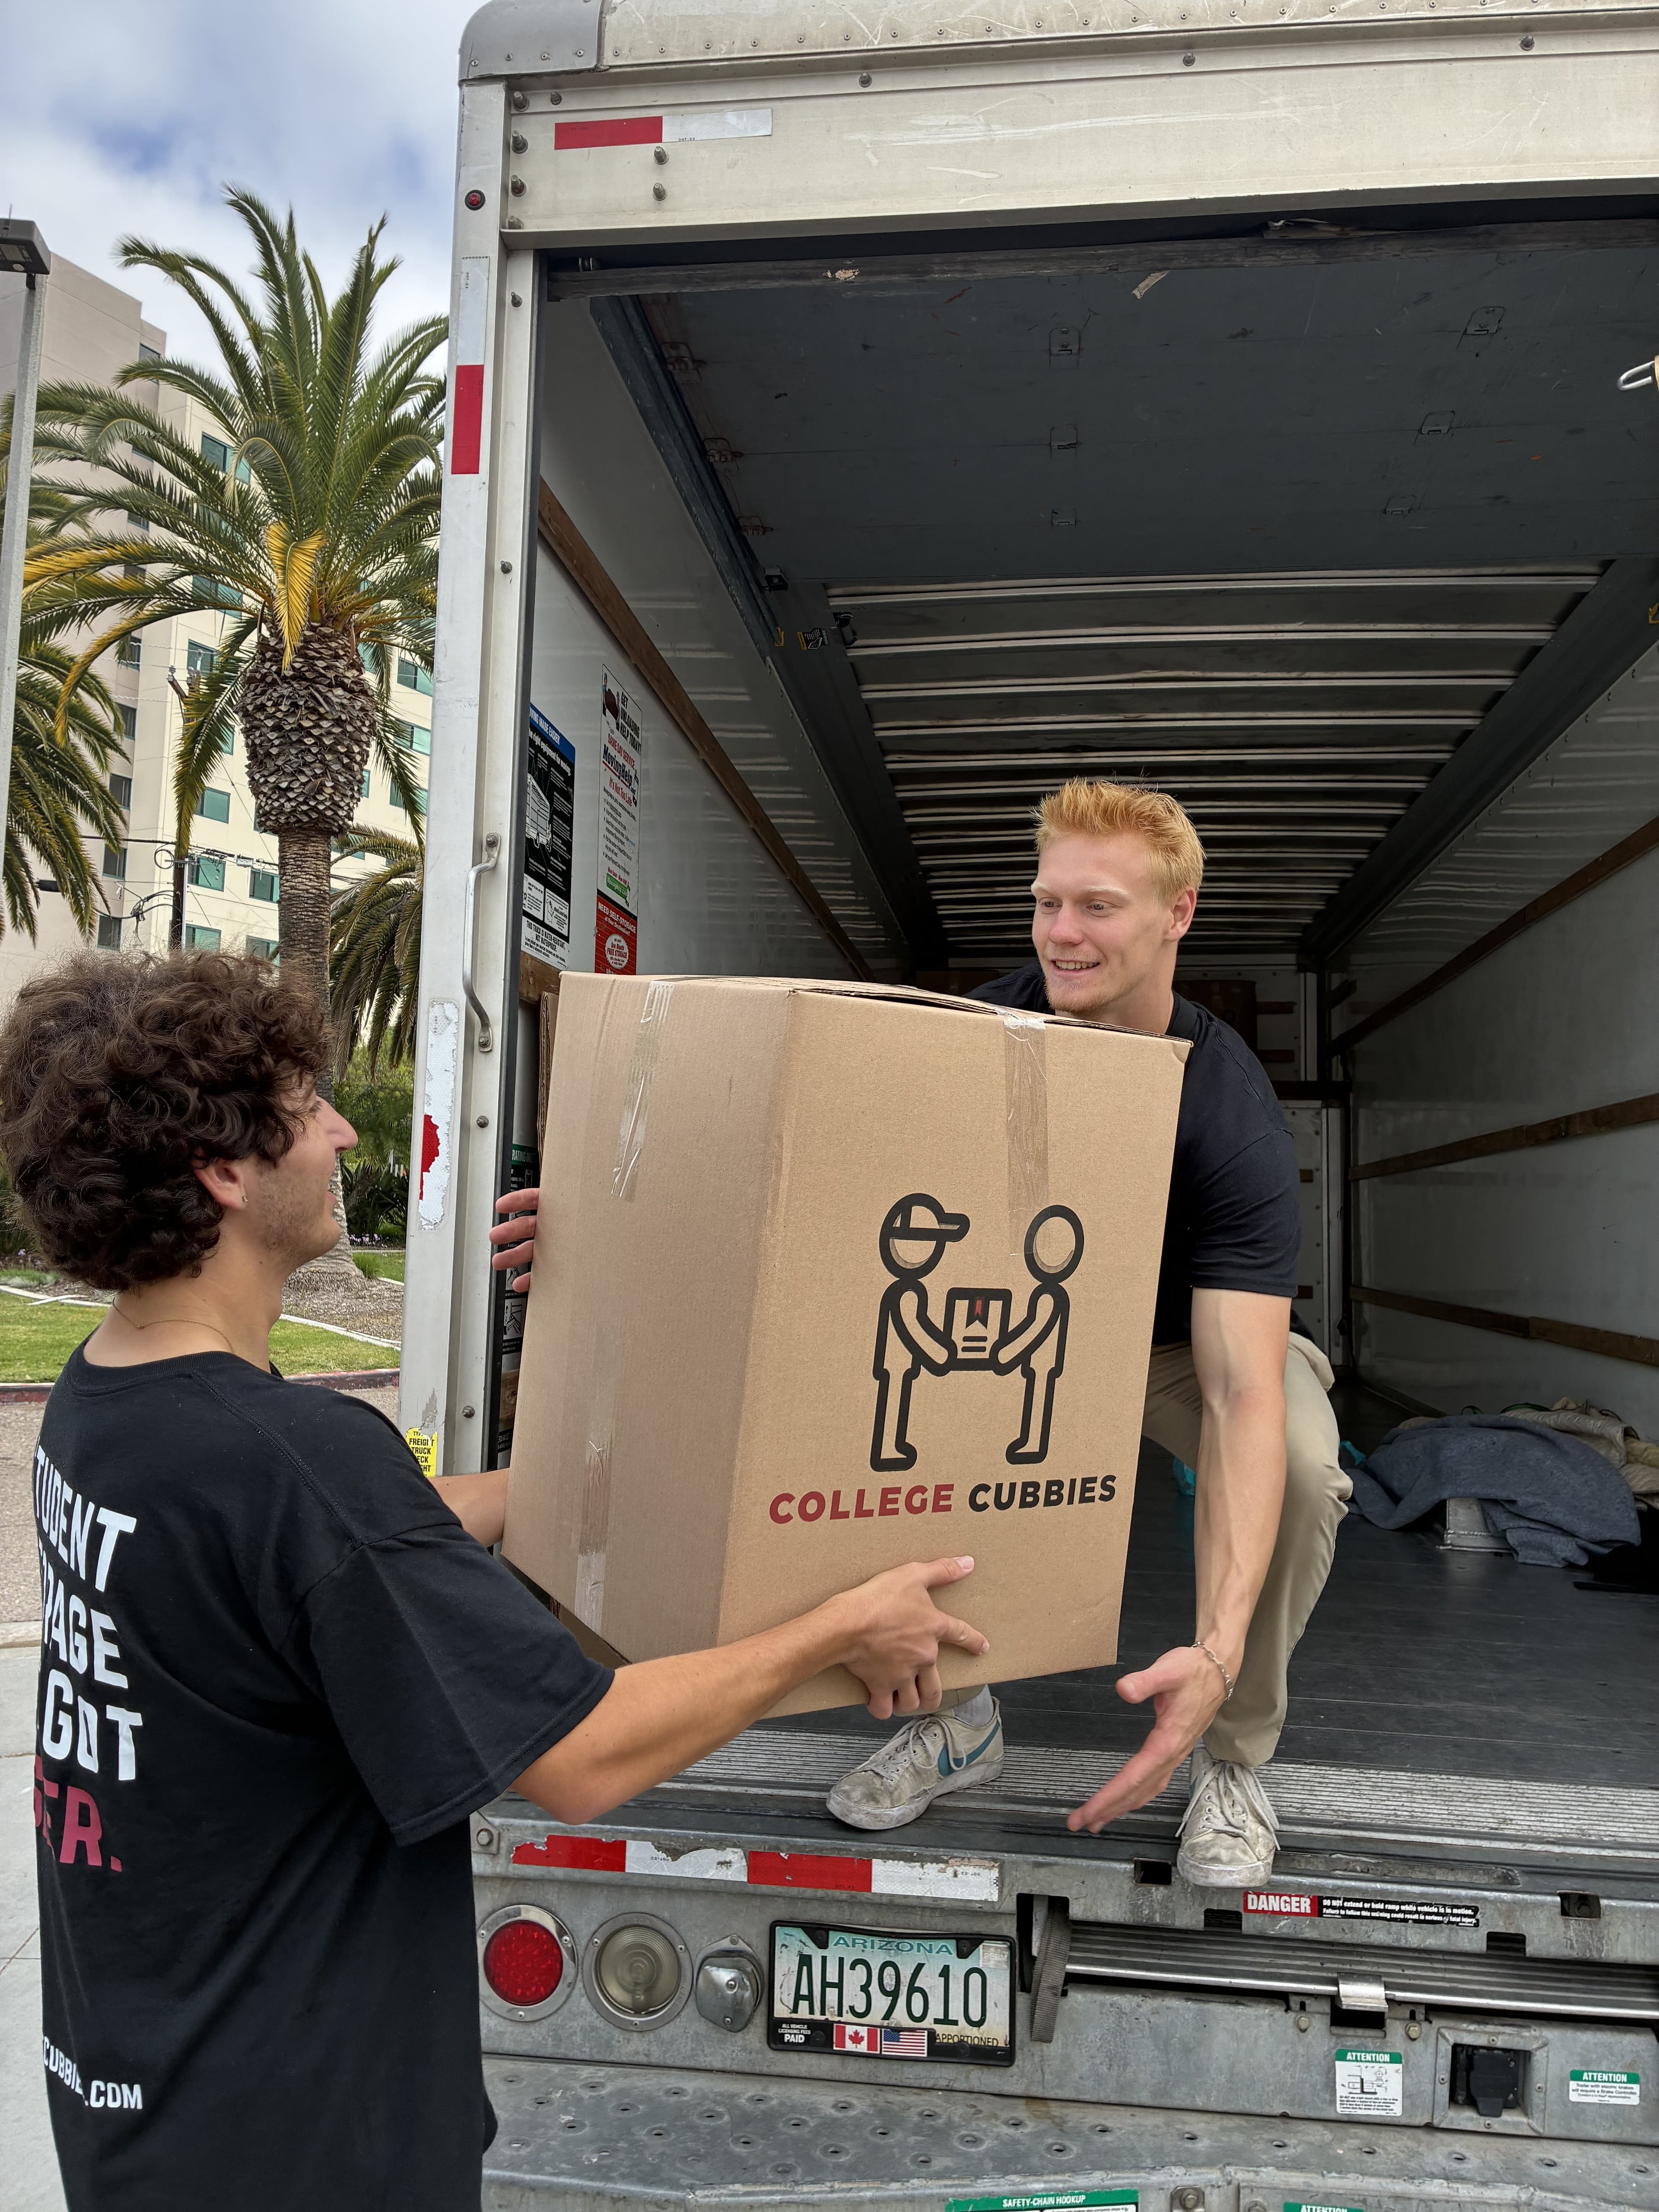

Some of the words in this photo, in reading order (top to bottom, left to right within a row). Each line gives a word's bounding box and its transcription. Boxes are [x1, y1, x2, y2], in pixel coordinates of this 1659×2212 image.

[598, 903, 609, 914] NEED
[769, 1484, 954, 1524] COLLEGE
[968, 1475, 1117, 1512] CUBBIES
[34, 1437, 137, 1592] TUDENT
[1247, 1894, 1311, 1913] DANGER
[833, 1936, 953, 1955] ARIZONA
[791, 1954, 987, 2028] AH39610
[784, 2034, 805, 2043] PAID
[936, 2033, 999, 2047] APPORTIONED
[1346, 2052, 1390, 2062] ATTENTION
[1583, 2072, 1627, 2082] ATTENTION
[1002, 2196, 1055, 2208] SAFETY-CHAIN
[1055, 2195, 1086, 2205] HOOKUP
